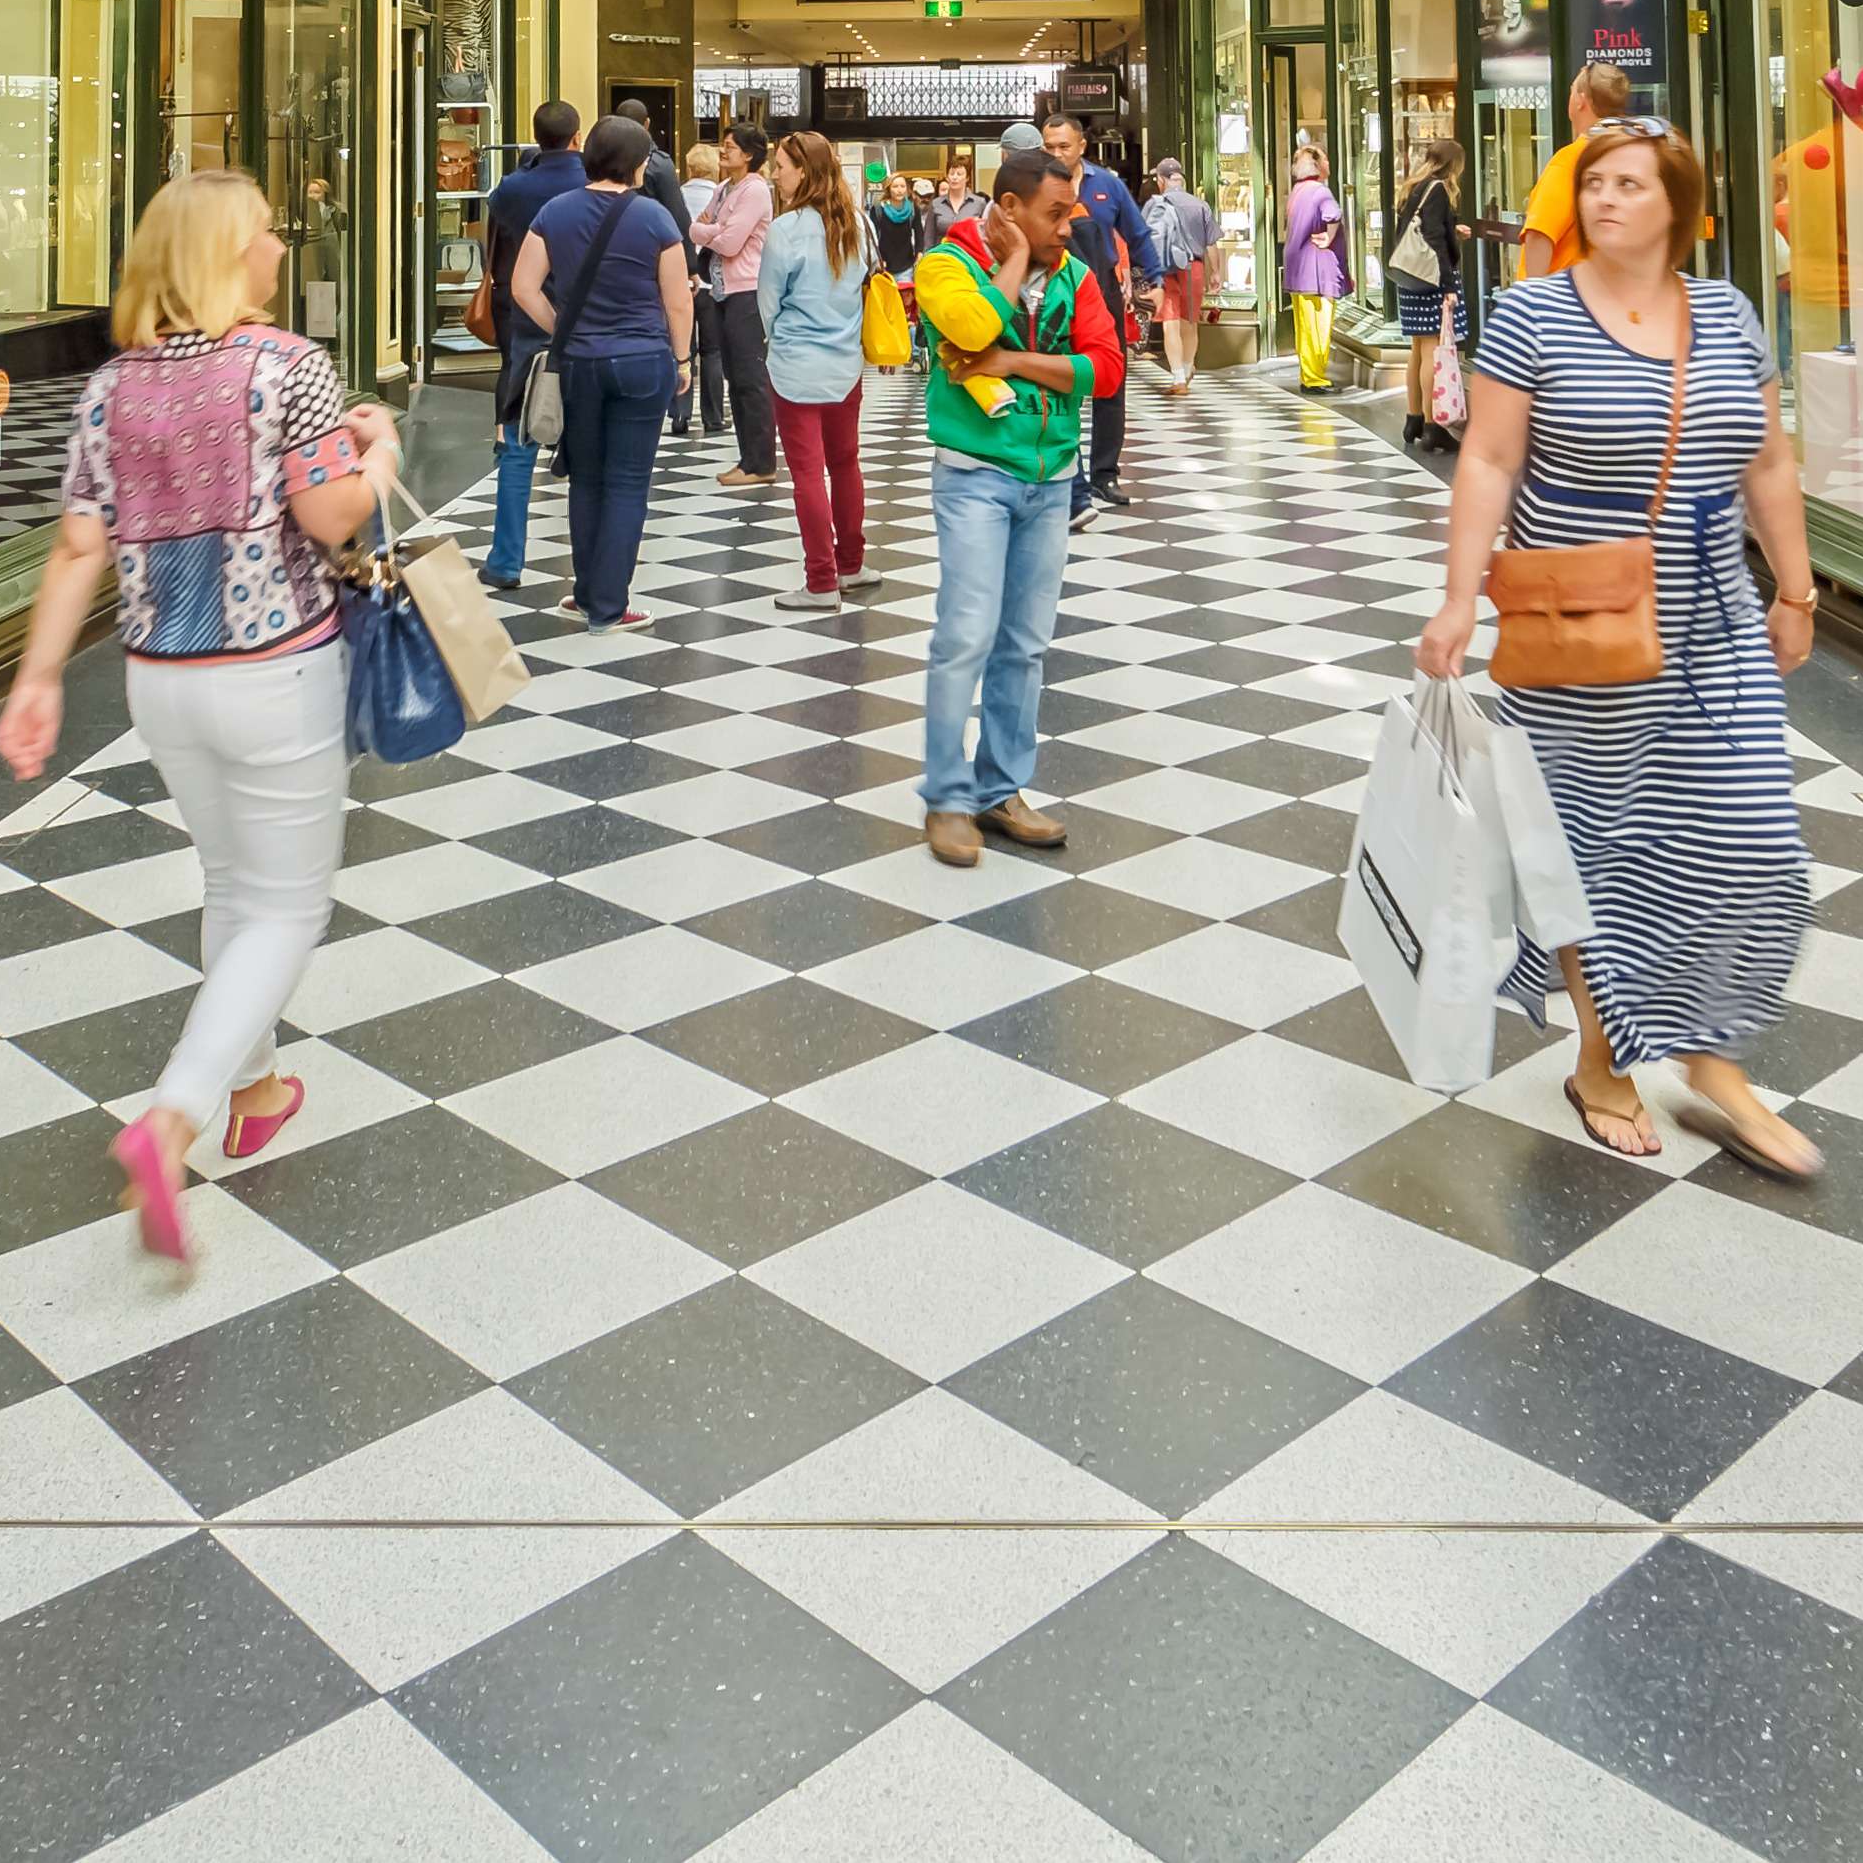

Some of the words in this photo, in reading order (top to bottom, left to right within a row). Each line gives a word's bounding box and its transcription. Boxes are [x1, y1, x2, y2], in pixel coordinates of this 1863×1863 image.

[1593, 26, 1642, 48] Pink
[1586, 48, 1652, 59] DIAMONDS
[1616, 58, 1652, 66] ARGYLE
